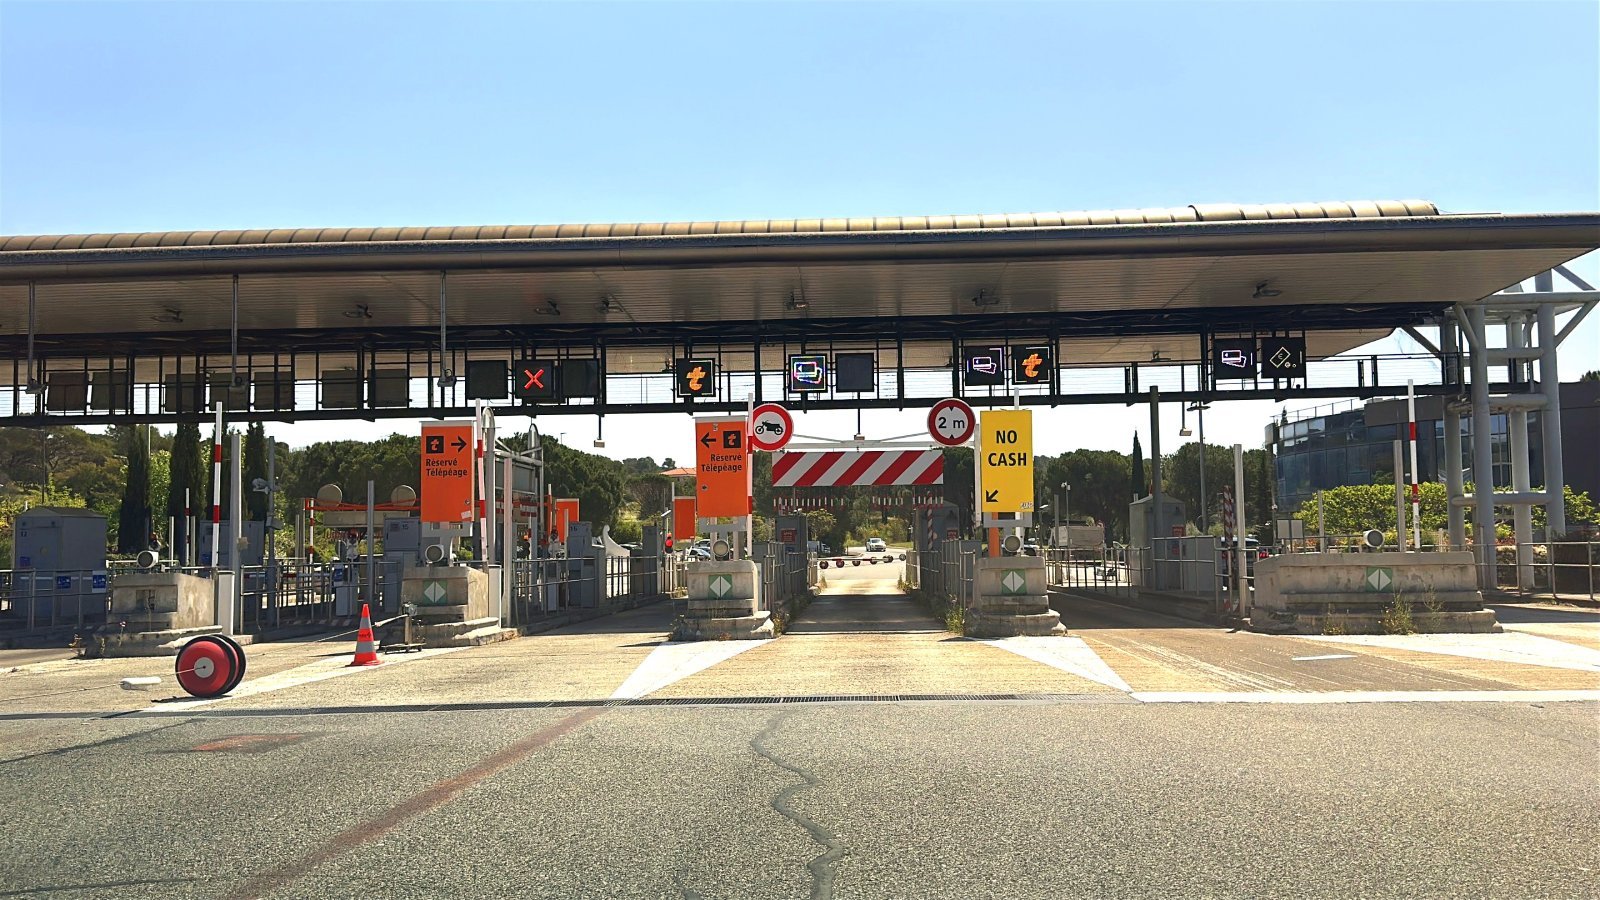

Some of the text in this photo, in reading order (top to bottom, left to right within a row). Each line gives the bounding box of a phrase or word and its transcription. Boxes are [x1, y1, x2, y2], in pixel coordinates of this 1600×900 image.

[938, 417, 965, 429] 2 m
[996, 430, 1018, 444] NO
[425, 458, 458, 467] Réservé
[710, 453, 742, 462] Réservé
[987, 452, 1027, 467] CASH
[426, 468, 468, 478] Télépéage
[701, 463, 743, 473] Télépéage
